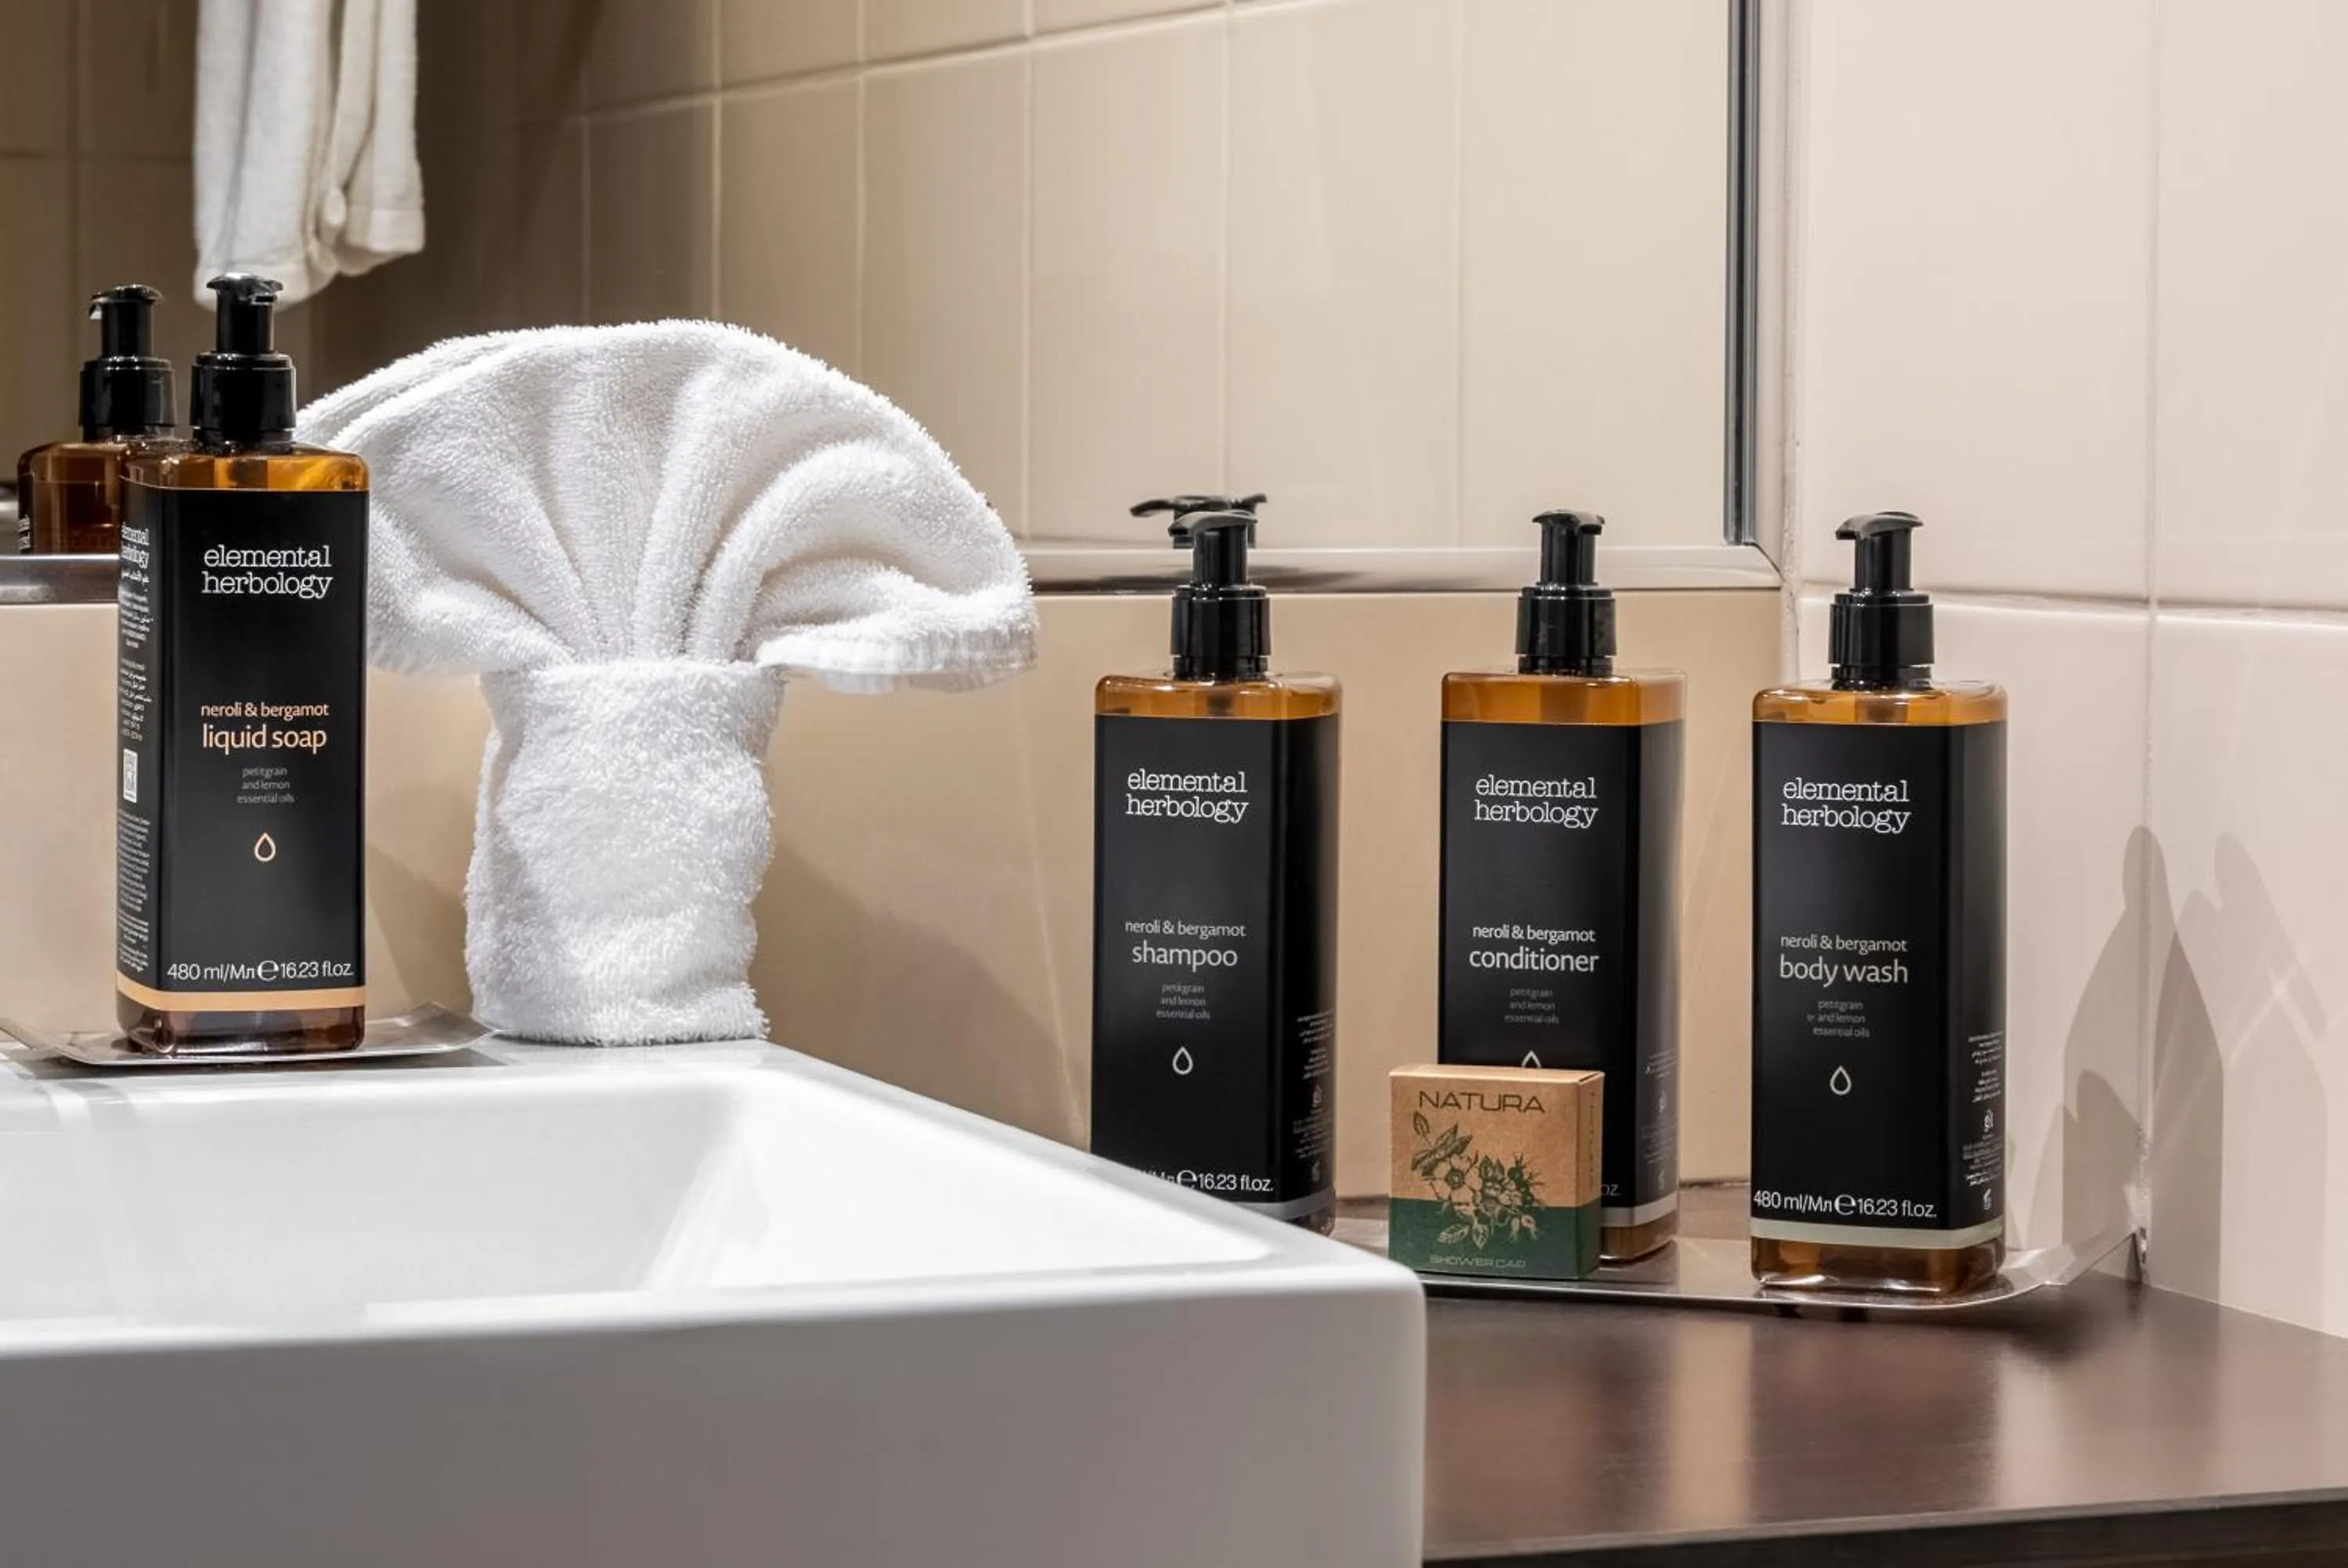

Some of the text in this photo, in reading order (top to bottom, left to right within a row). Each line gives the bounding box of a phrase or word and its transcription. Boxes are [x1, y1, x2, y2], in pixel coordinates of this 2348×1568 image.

[204, 545, 332, 567] elemental
[202, 571, 333, 599] herbology
[201, 702, 329, 721] neroli & bergamot
[203, 724, 326, 754] liquid soap
[1128, 768, 1248, 793] elemental
[1476, 774, 1597, 798] elemental
[1782, 777, 1909, 804] elemental
[1125, 793, 1249, 823] herbology
[1475, 800, 1598, 829] herbology
[1781, 804, 1910, 833] herbology
[1125, 919, 1246, 940] neroli & bergamot
[1473, 924, 1595, 945] neroli & bergamot
[1133, 937, 1237, 972] shampoo
[1781, 934, 1907, 955] neroli & bergamot
[1470, 946, 1598, 971] conditioner
[1781, 954, 1907, 987] body wash
[167, 964, 200, 980] 480
[1419, 1091, 1545, 1113] NATURA
[1198, 1174, 1237, 1190] 16.23
[1753, 1191, 1781, 1208] 480
